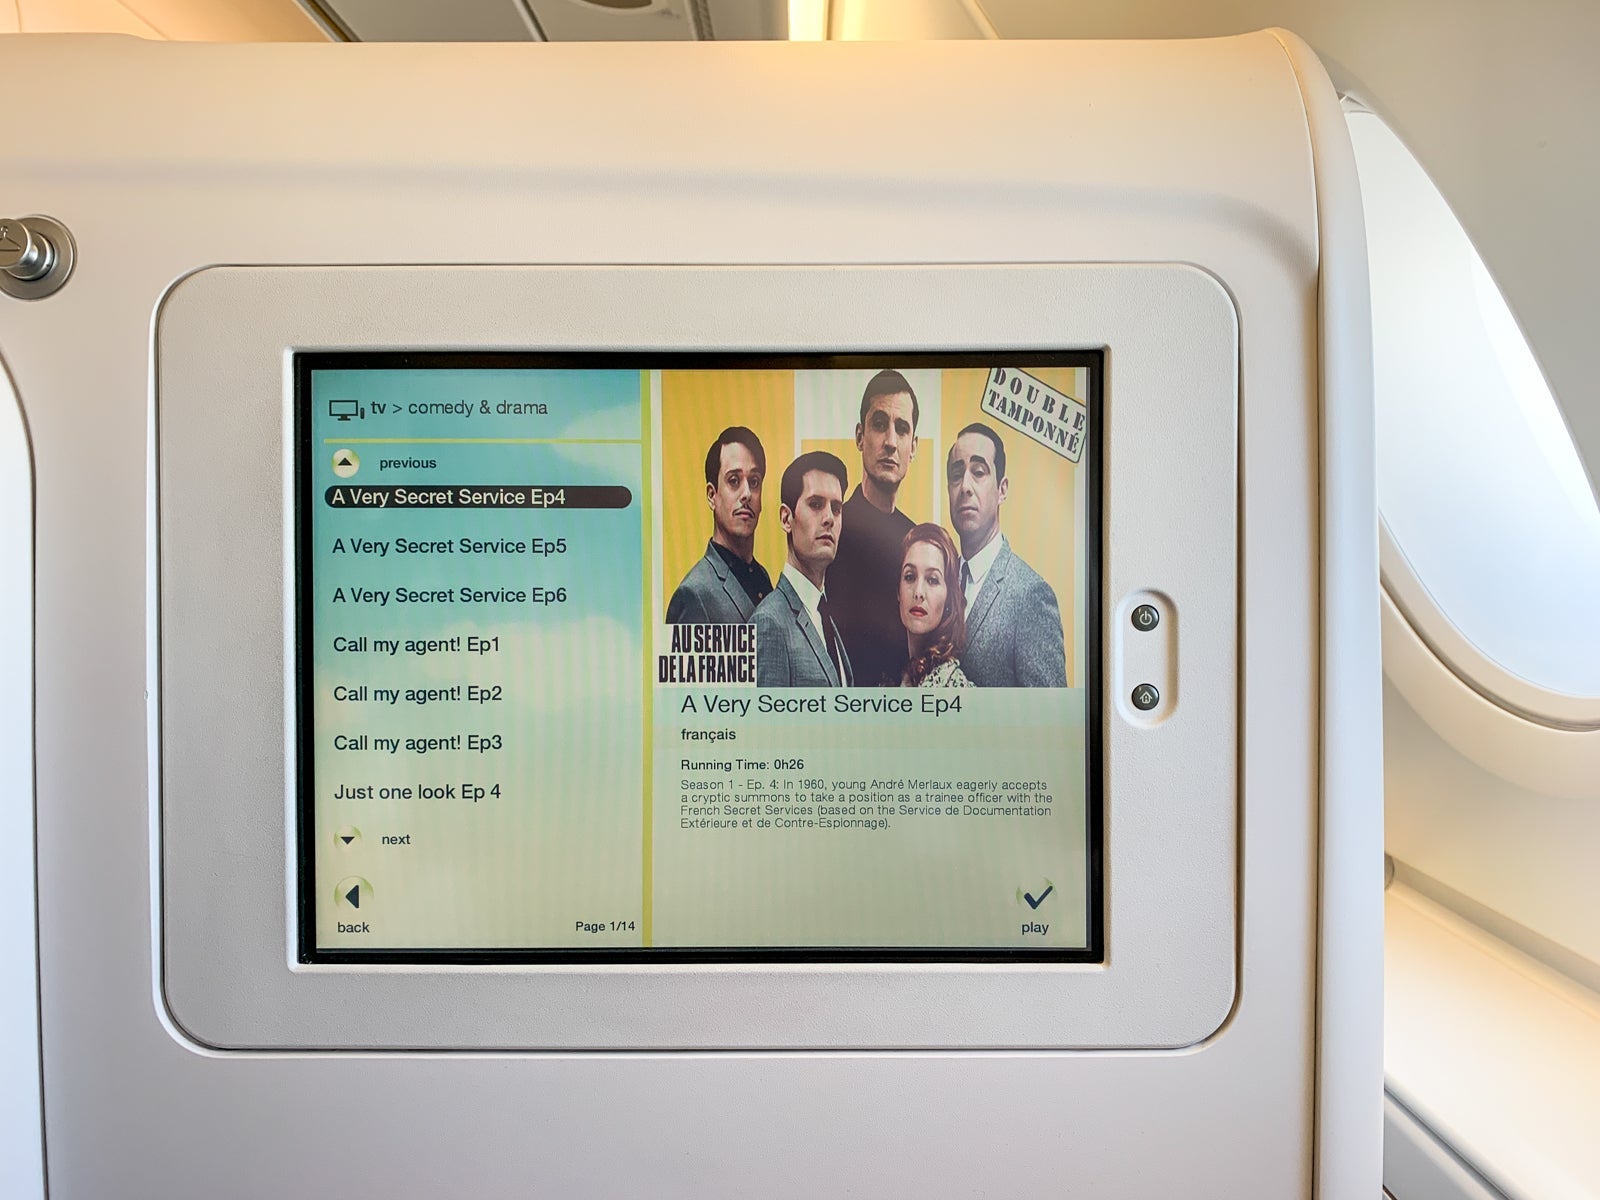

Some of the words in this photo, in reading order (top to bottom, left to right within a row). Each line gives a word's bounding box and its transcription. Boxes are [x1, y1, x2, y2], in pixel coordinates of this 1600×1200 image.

[993, 367, 1085, 431] DOUBLE
[370, 402, 386, 414] tv
[409, 400, 474, 418] comedy
[480, 400, 491, 414] &
[496, 400, 548, 414] drama
[988, 389, 1079, 454] TAMPONNÉ
[380, 457, 436, 471] previous
[332, 489, 345, 504] A
[350, 489, 389, 508] Very
[395, 489, 453, 504] Secret
[459, 489, 525, 504] Service
[532, 489, 566, 508] Ep4
[332, 538, 346, 553] A
[350, 538, 390, 557] Very
[396, 538, 454, 553] Secret
[460, 538, 526, 553] Service
[532, 538, 566, 557] Ep5
[333, 588, 346, 602] A
[351, 588, 390, 606] Very
[396, 588, 454, 602] Secret
[460, 588, 526, 602] Service
[533, 588, 566, 606] Ep6
[334, 637, 366, 652] Call
[374, 641, 399, 655] my
[405, 637, 460, 655] agent!
[468, 637, 498, 655] Ep1
[694, 625, 755, 653] SERVICE
[698, 655, 755, 683] FRANCE
[334, 686, 367, 701] Call
[374, 690, 400, 704] my
[406, 686, 460, 704] agent!
[468, 686, 502, 704] Ep2
[681, 695, 697, 712] A
[704, 695, 750, 717] Very
[758, 695, 826, 712] Secret
[834, 695, 912, 712] Service
[922, 695, 962, 717] Ep4
[334, 736, 367, 750] Call
[374, 739, 400, 754] my
[406, 735, 460, 754] agent!
[468, 735, 502, 753] Ep3
[681, 728, 736, 743] français
[682, 760, 732, 772] Running
[736, 759, 769, 770] Time:
[774, 759, 804, 769] 0h26
[334, 784, 373, 799] Just
[380, 788, 412, 799] one
[419, 784, 455, 799] look
[462, 784, 485, 802] Ep
[490, 784, 501, 798] 4
[681, 780, 723, 790] Season
[747, 779, 764, 791] Ep.
[770, 780, 778, 789] 4:
[784, 780, 793, 789] In
[798, 780, 827, 791] 1960,
[832, 780, 866, 792] young
[870, 779, 904, 789] André
[908, 779, 952, 789] Merlaux
[956, 780, 998, 792] eagerly
[1002, 780, 1048, 792] accepts
[692, 792, 730, 804] cryptic
[735, 794, 790, 802] summons
[795, 793, 806, 802] to
[810, 792, 834, 802] take
[839, 794, 845, 802] a
[849, 792, 894, 804] position
[898, 794, 910, 802] as
[915, 794, 922, 802] a
[925, 792, 964, 802] trainee
[968, 792, 1003, 802] officer
[1006, 793, 1031, 802] with
[1034, 793, 1052, 803] the
[680, 806, 720, 816] French
[724, 805, 760, 815] Secret
[765, 805, 812, 815] Services
[818, 805, 855, 817] (based
[860, 807, 873, 815] on
[877, 805, 895, 815] the
[899, 805, 941, 815] Service
[945, 805, 959, 815] de
[964, 805, 1051, 816] Documentation
[681, 818, 738, 829] Extérieure
[742, 818, 752, 828] et
[756, 818, 770, 828] de
[774, 818, 890, 830] Contre-Espionnage).
[382, 834, 410, 844] next
[338, 922, 370, 933] back
[576, 922, 605, 933] Page
[610, 921, 635, 931] 1/14
[1022, 922, 1049, 935] play
